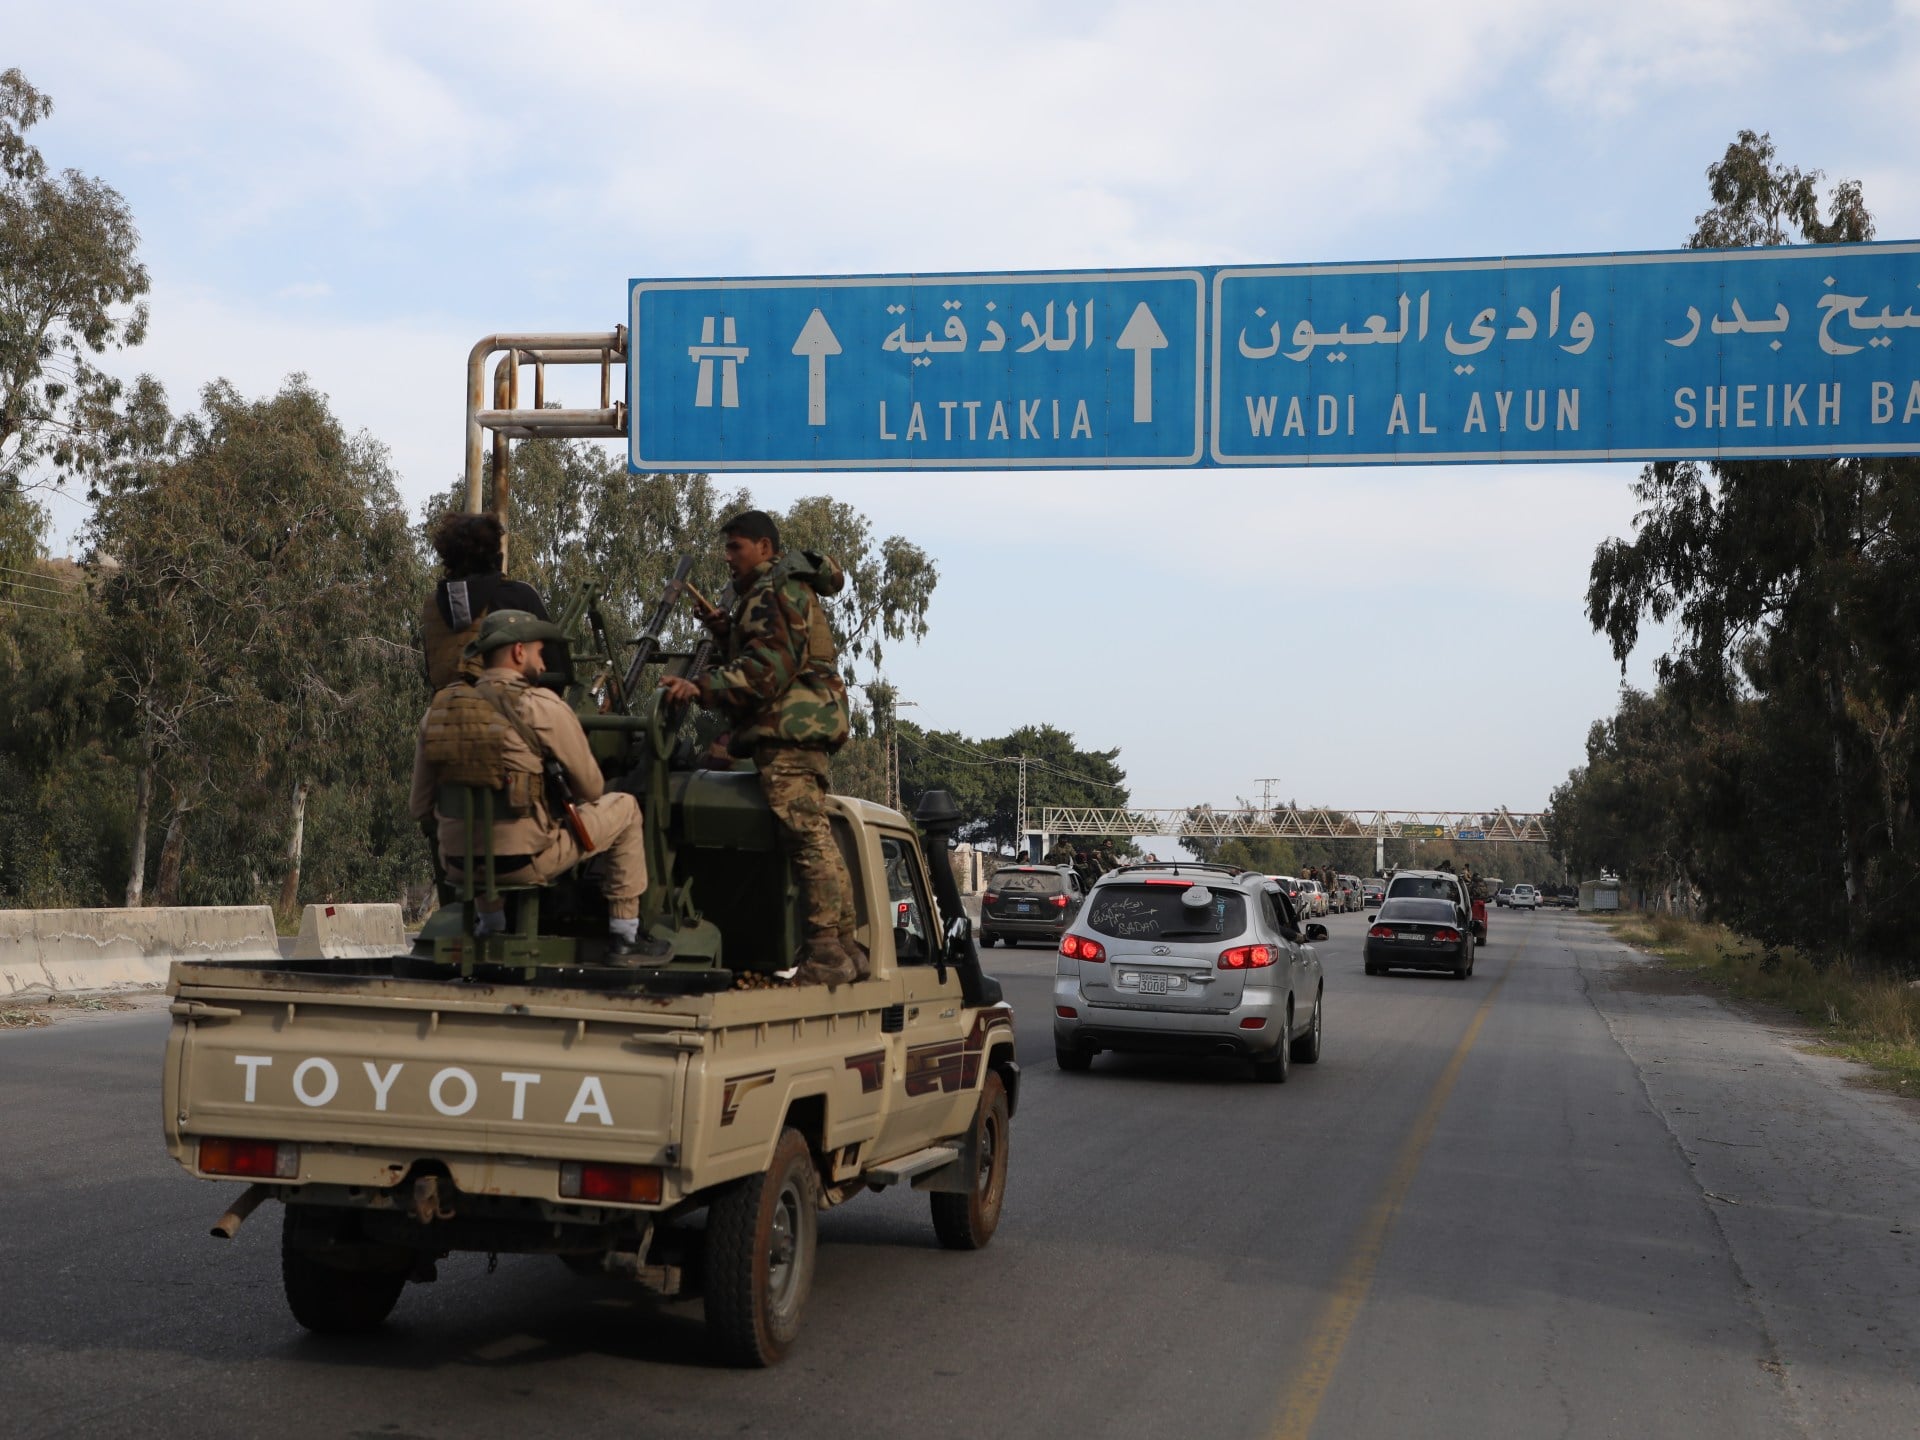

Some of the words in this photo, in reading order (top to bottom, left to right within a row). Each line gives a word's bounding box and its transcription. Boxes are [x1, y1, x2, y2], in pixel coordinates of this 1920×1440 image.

[881, 298, 1094, 367] اللاذقية
[1238, 290, 1430, 363] العيون
[1444, 285, 1595, 375] وادي
[1665, 297, 1790, 352] بدر
[879, 399, 1092, 441] LATTAKIA
[1245, 394, 1355, 437] WADI
[1386, 392, 1437, 435] AL
[1463, 388, 1580, 433] AYUN
[1674, 382, 1841, 429] SHEIKH
[1141, 981, 1166, 992] 3008
[234, 1055, 614, 1126] TOYOTA
